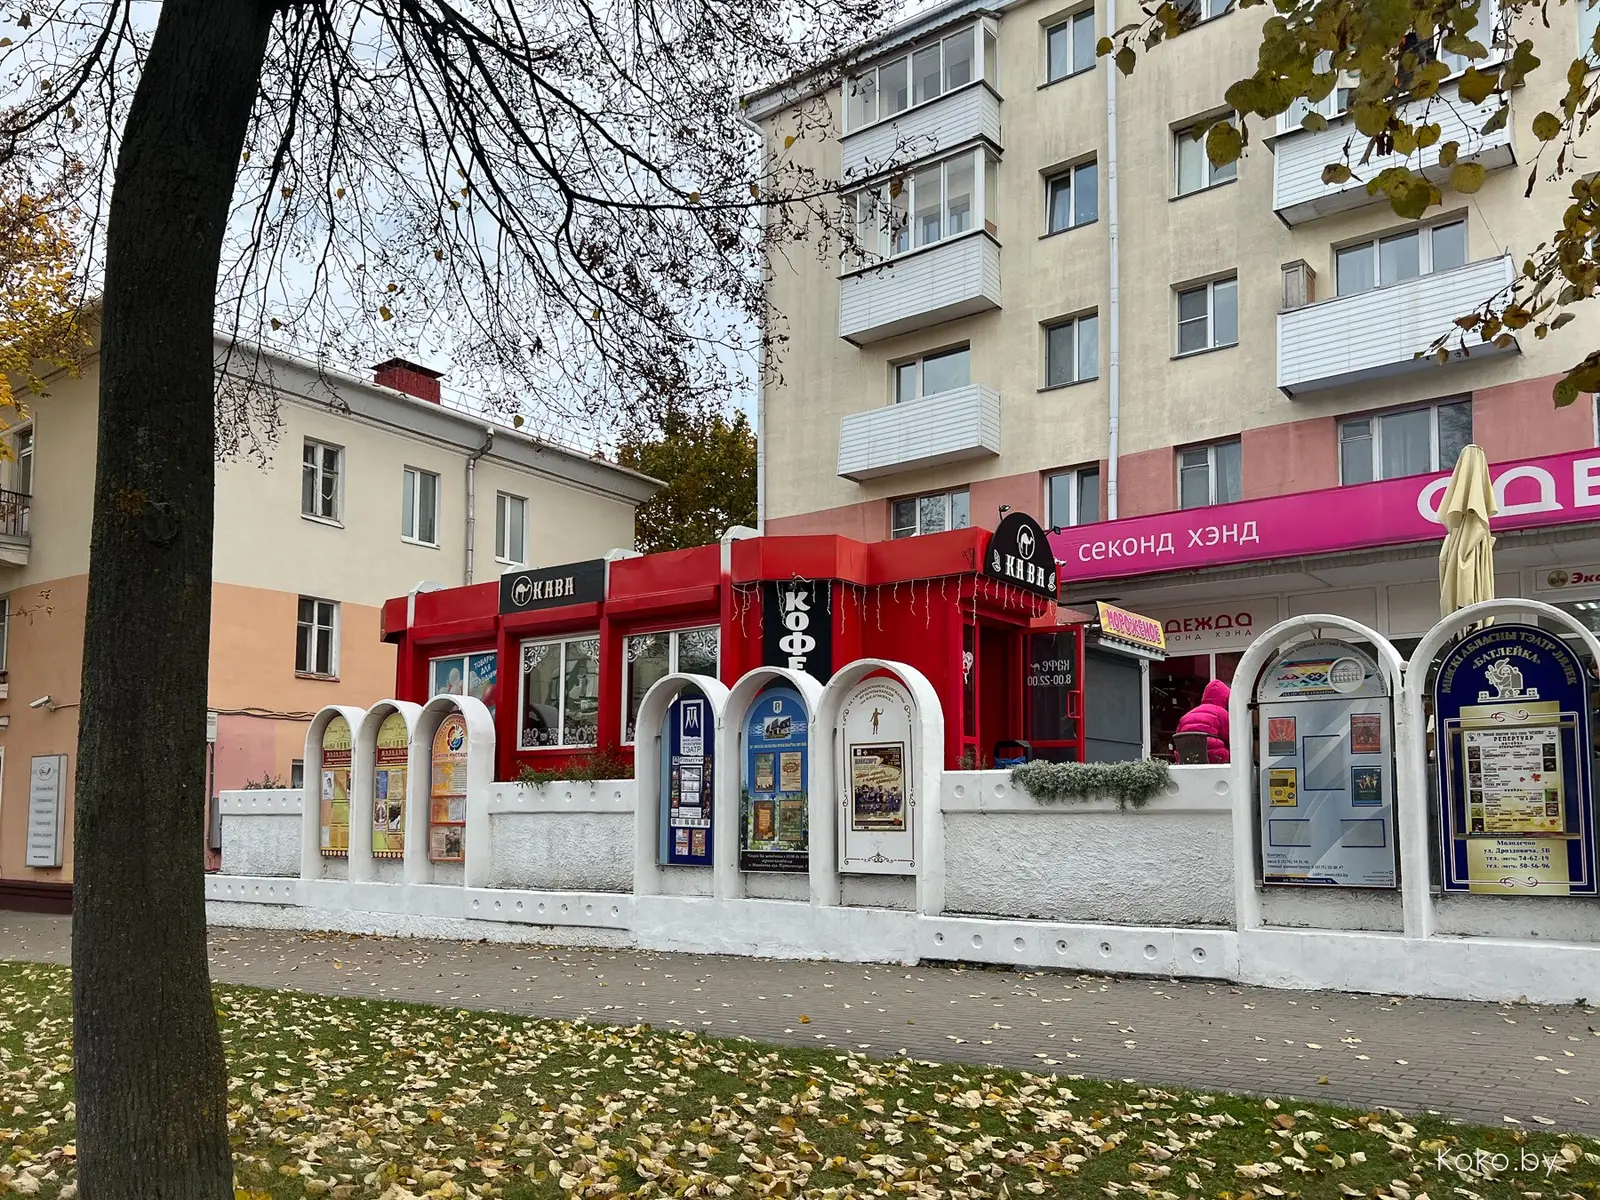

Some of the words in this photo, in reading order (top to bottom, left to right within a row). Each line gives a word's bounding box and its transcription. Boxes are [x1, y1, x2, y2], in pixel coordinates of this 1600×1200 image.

[1004, 553, 1046, 589] КАВА
[531, 576, 576, 601] КАВА
[1106, 608, 1162, 645] МОРОЖЕНОЕ
[1519, 631, 1557, 652] ТЭАТР
[682, 745, 702, 754] ТЭАТР
